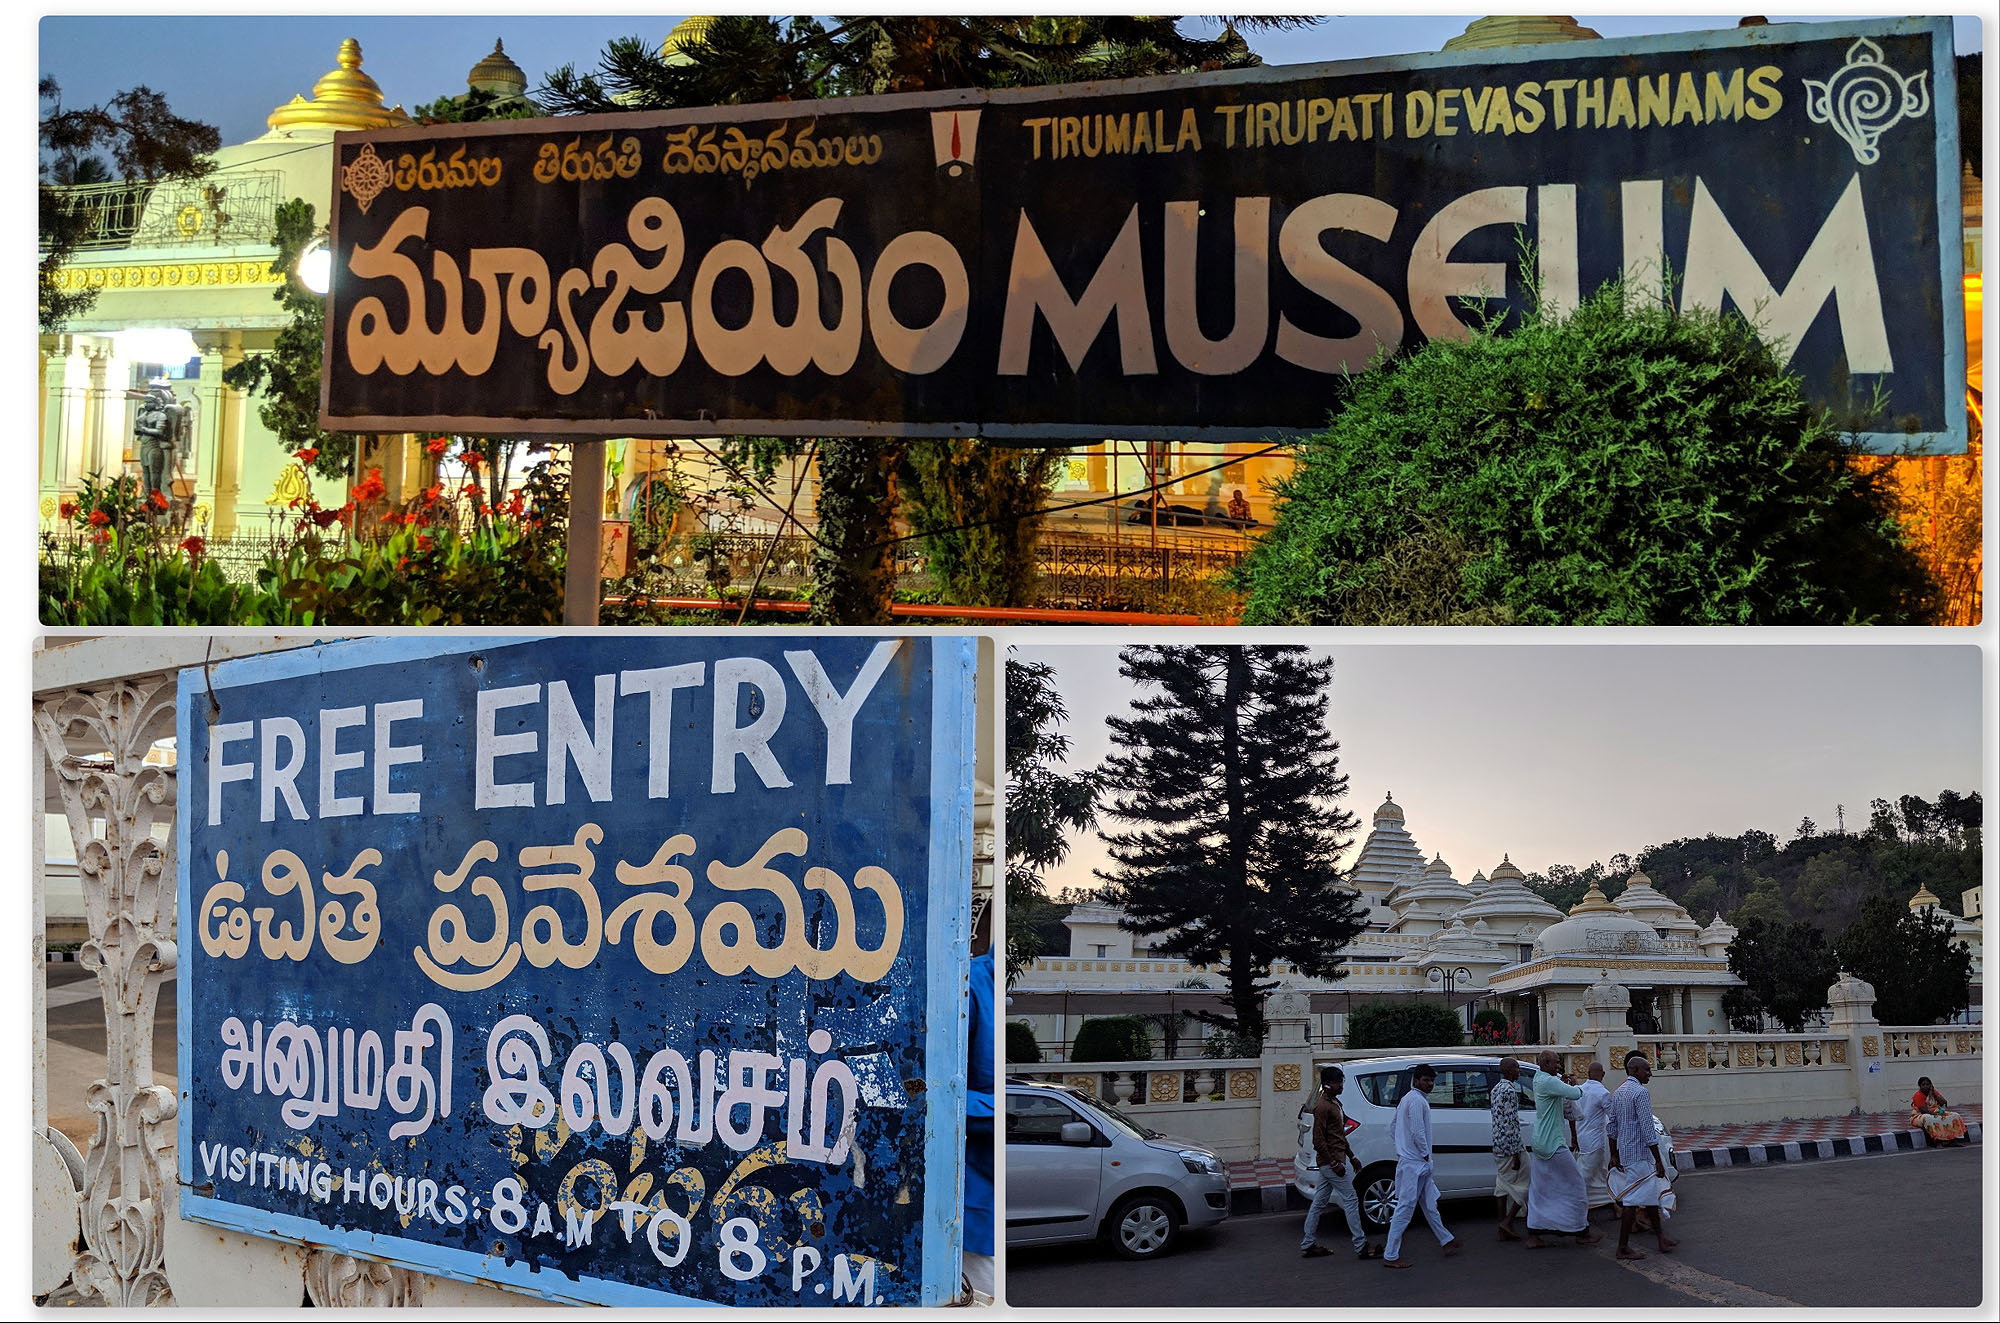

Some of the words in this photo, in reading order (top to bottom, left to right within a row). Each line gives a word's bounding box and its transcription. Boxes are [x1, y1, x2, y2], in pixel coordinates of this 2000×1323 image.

[395, 142, 502, 191] తిరుమల
[533, 131, 642, 183] తిరుపతి
[662, 119, 883, 190] దేవస్థానములు
[1021, 107, 1202, 161] TIRUMALA
[1213, 92, 1393, 150] TIRUPATI
[1405, 65, 1784, 139] DEVASTHANAMS
[347, 196, 969, 395] మ్యూజియం
[997, 172, 1893, 375] MUSEUM
[207, 698, 424, 826] FREE
[475, 639, 904, 810] ENTRY
[199, 848, 382, 965] ఉచిత
[413, 822, 903, 991] ప్రవేశము
[220, 1002, 454, 1141] அனுமதி
[482, 1014, 859, 1166] இலவசம்
[199, 1140, 332, 1204] VISITING
[343, 1167, 481, 1225] HOURS:
[609, 1200, 692, 1267] TO
[719, 1217, 767, 1281] 8
